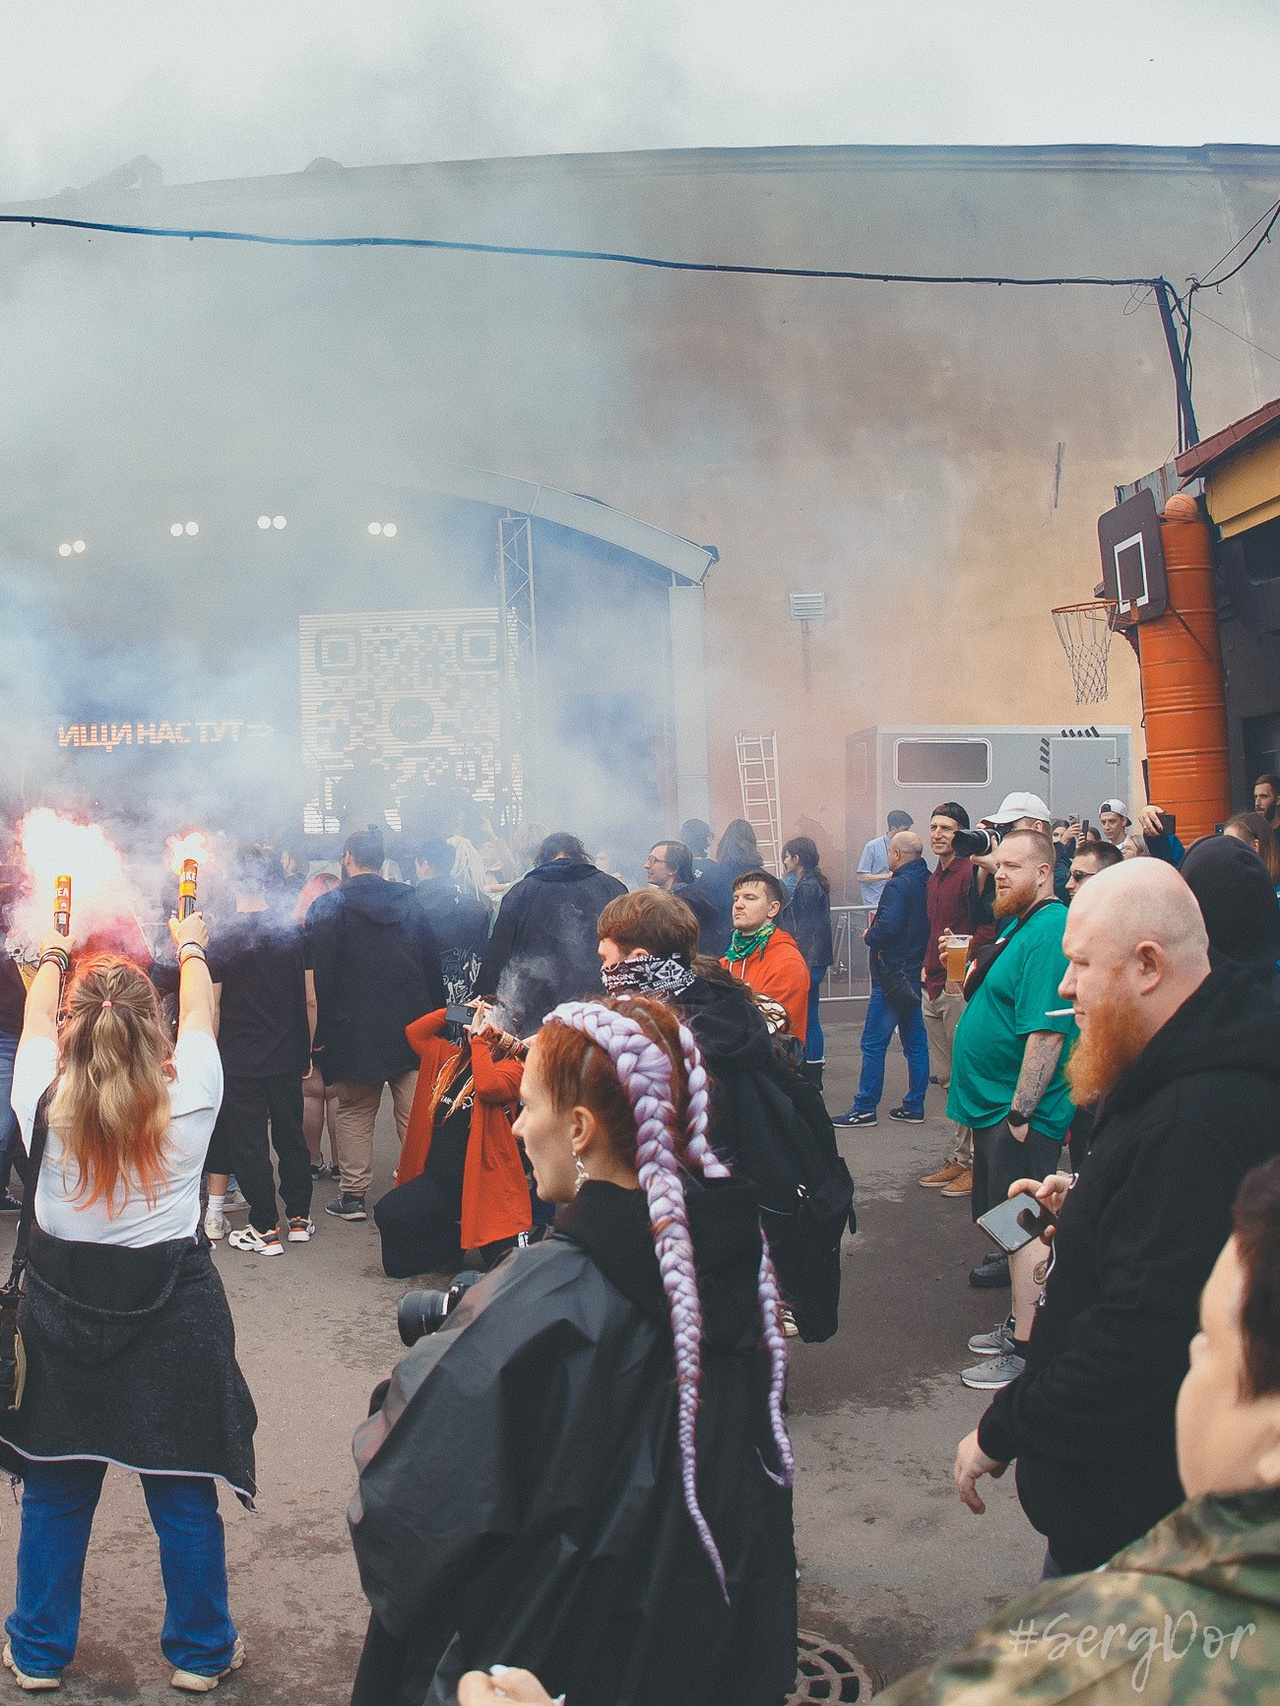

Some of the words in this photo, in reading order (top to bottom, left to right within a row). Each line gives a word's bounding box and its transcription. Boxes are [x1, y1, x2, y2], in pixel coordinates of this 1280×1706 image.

[58, 719, 132, 752] ИЩИ
[137, 719, 191, 745] НАС
[195, 718, 244, 743] ТУТ
